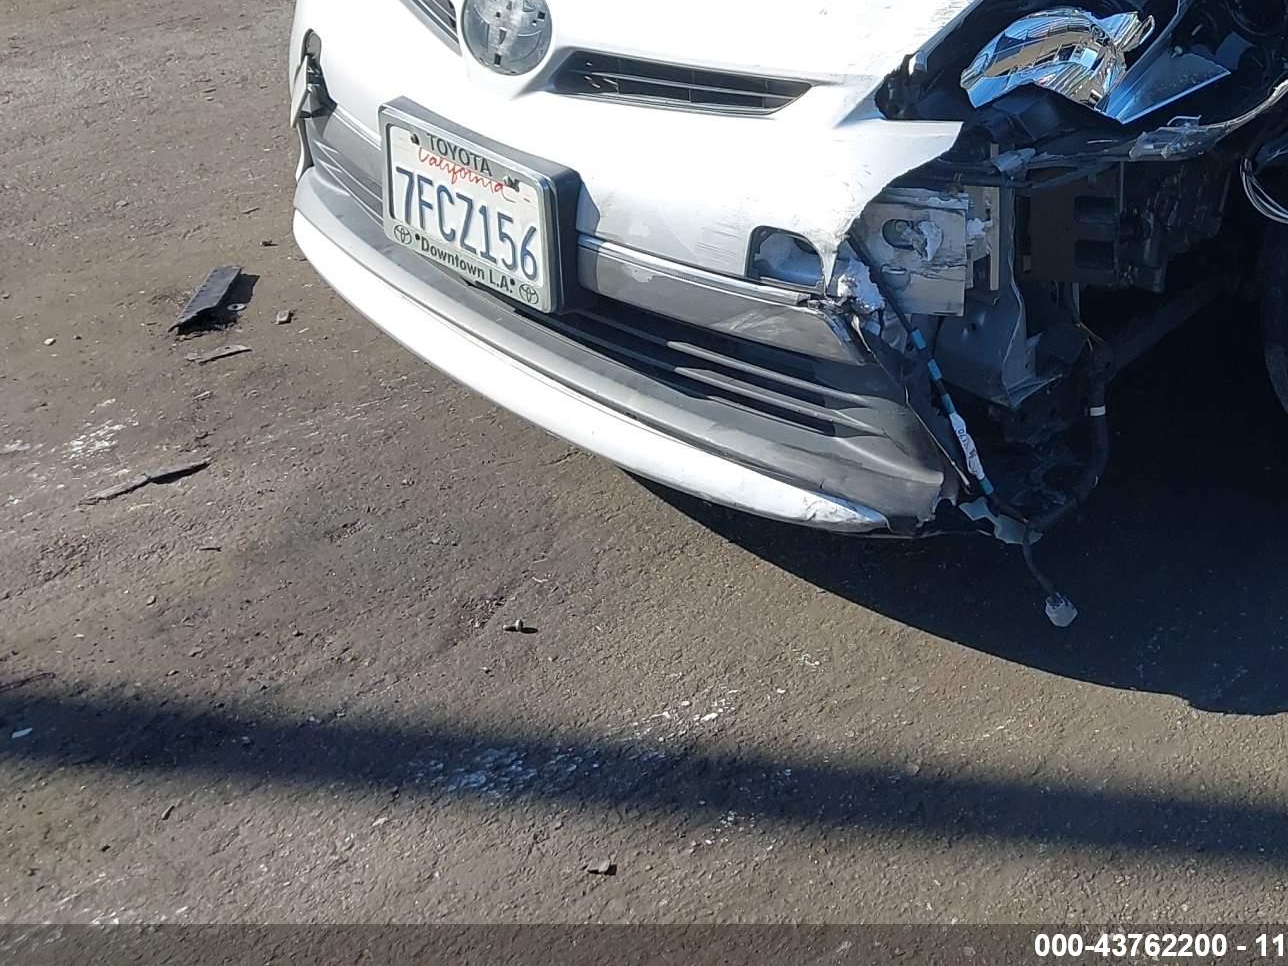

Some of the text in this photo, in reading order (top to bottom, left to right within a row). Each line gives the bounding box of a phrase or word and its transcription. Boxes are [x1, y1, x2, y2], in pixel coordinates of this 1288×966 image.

[418, 146, 516, 204] California
[427, 133, 493, 177] TOYOTA
[395, 165, 538, 281] 7FCZ156
[421, 235, 514, 294] Downtown L.A.
